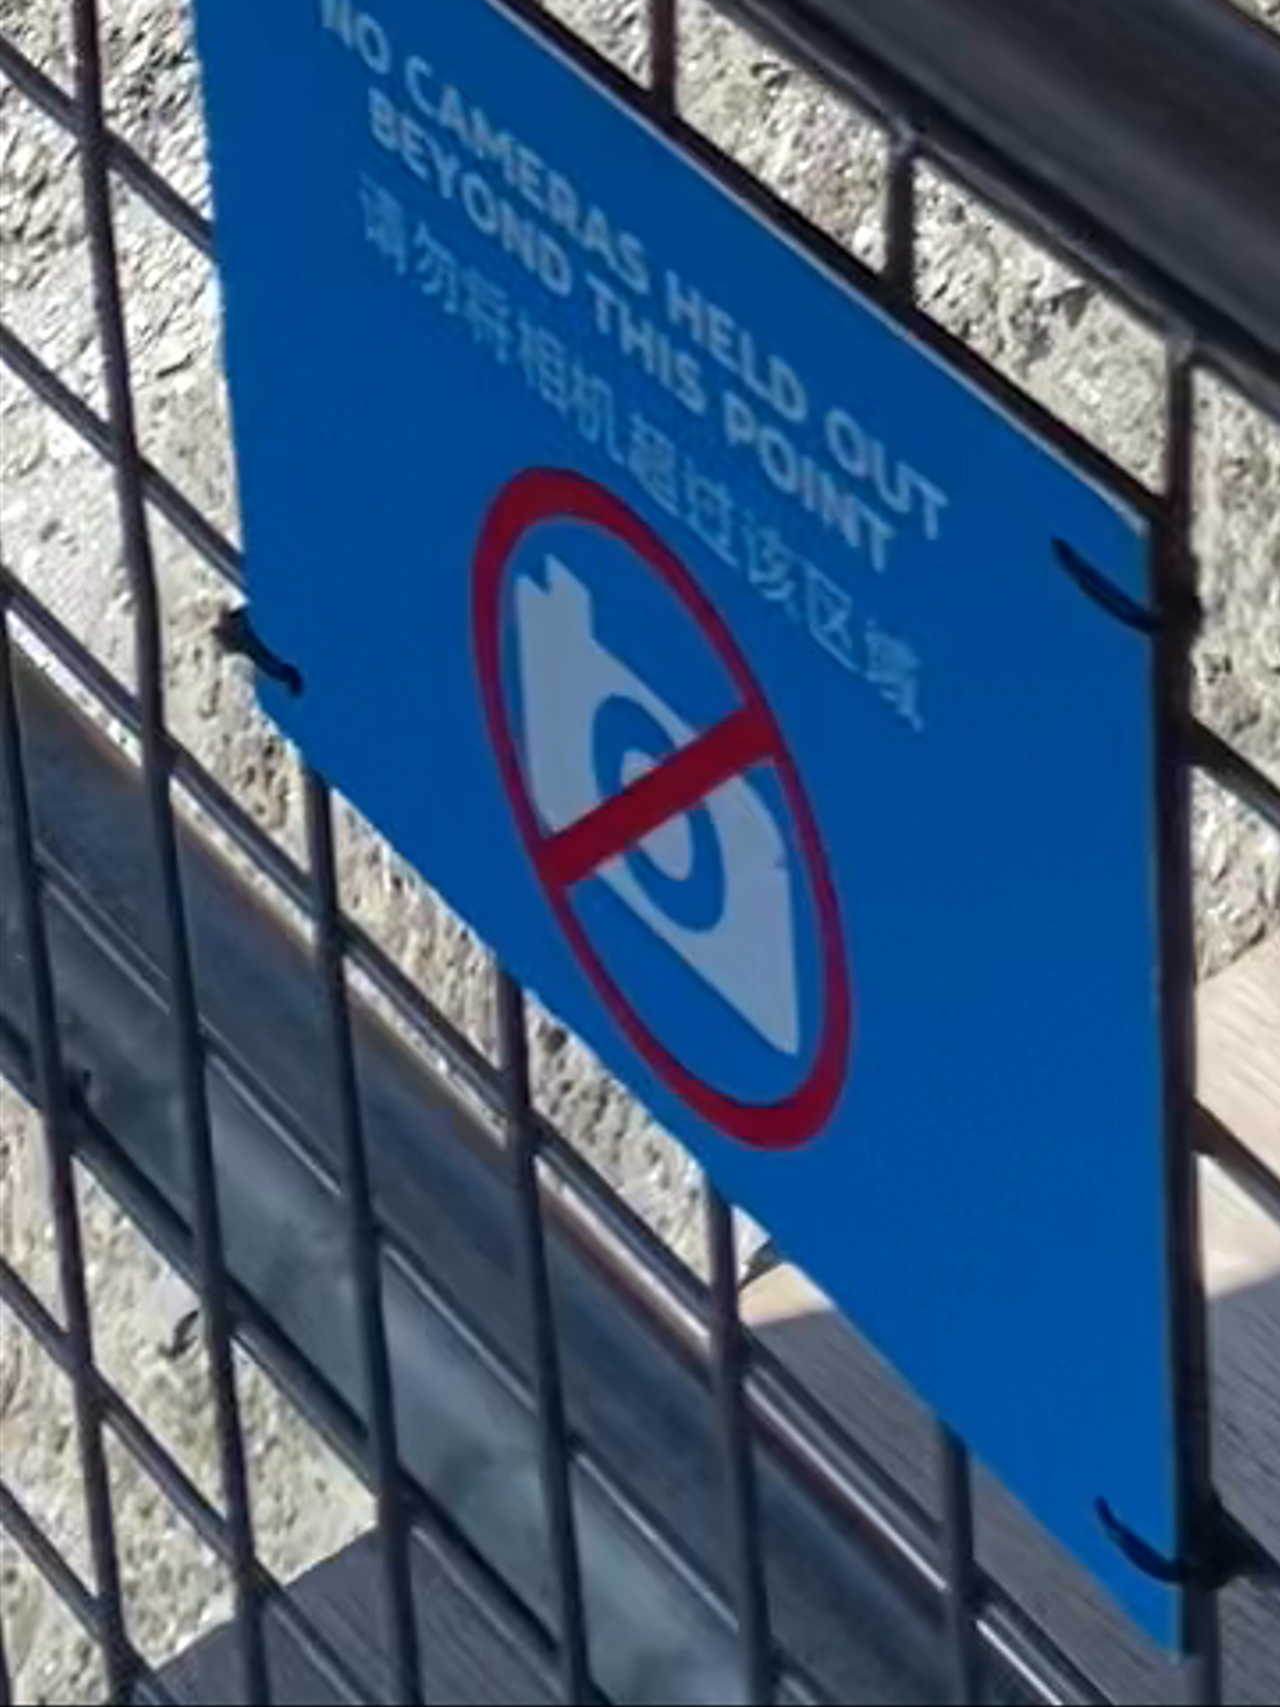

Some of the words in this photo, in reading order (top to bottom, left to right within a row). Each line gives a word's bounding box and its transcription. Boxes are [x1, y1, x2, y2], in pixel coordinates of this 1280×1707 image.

[367, 86, 573, 297] BEYOND
[585, 273, 707, 415] THIS
[722, 390, 893, 572] POINT
[404, 53, 651, 296] CAMERAS
[665, 270, 808, 424] HELD
[823, 407, 949, 541] OUT
